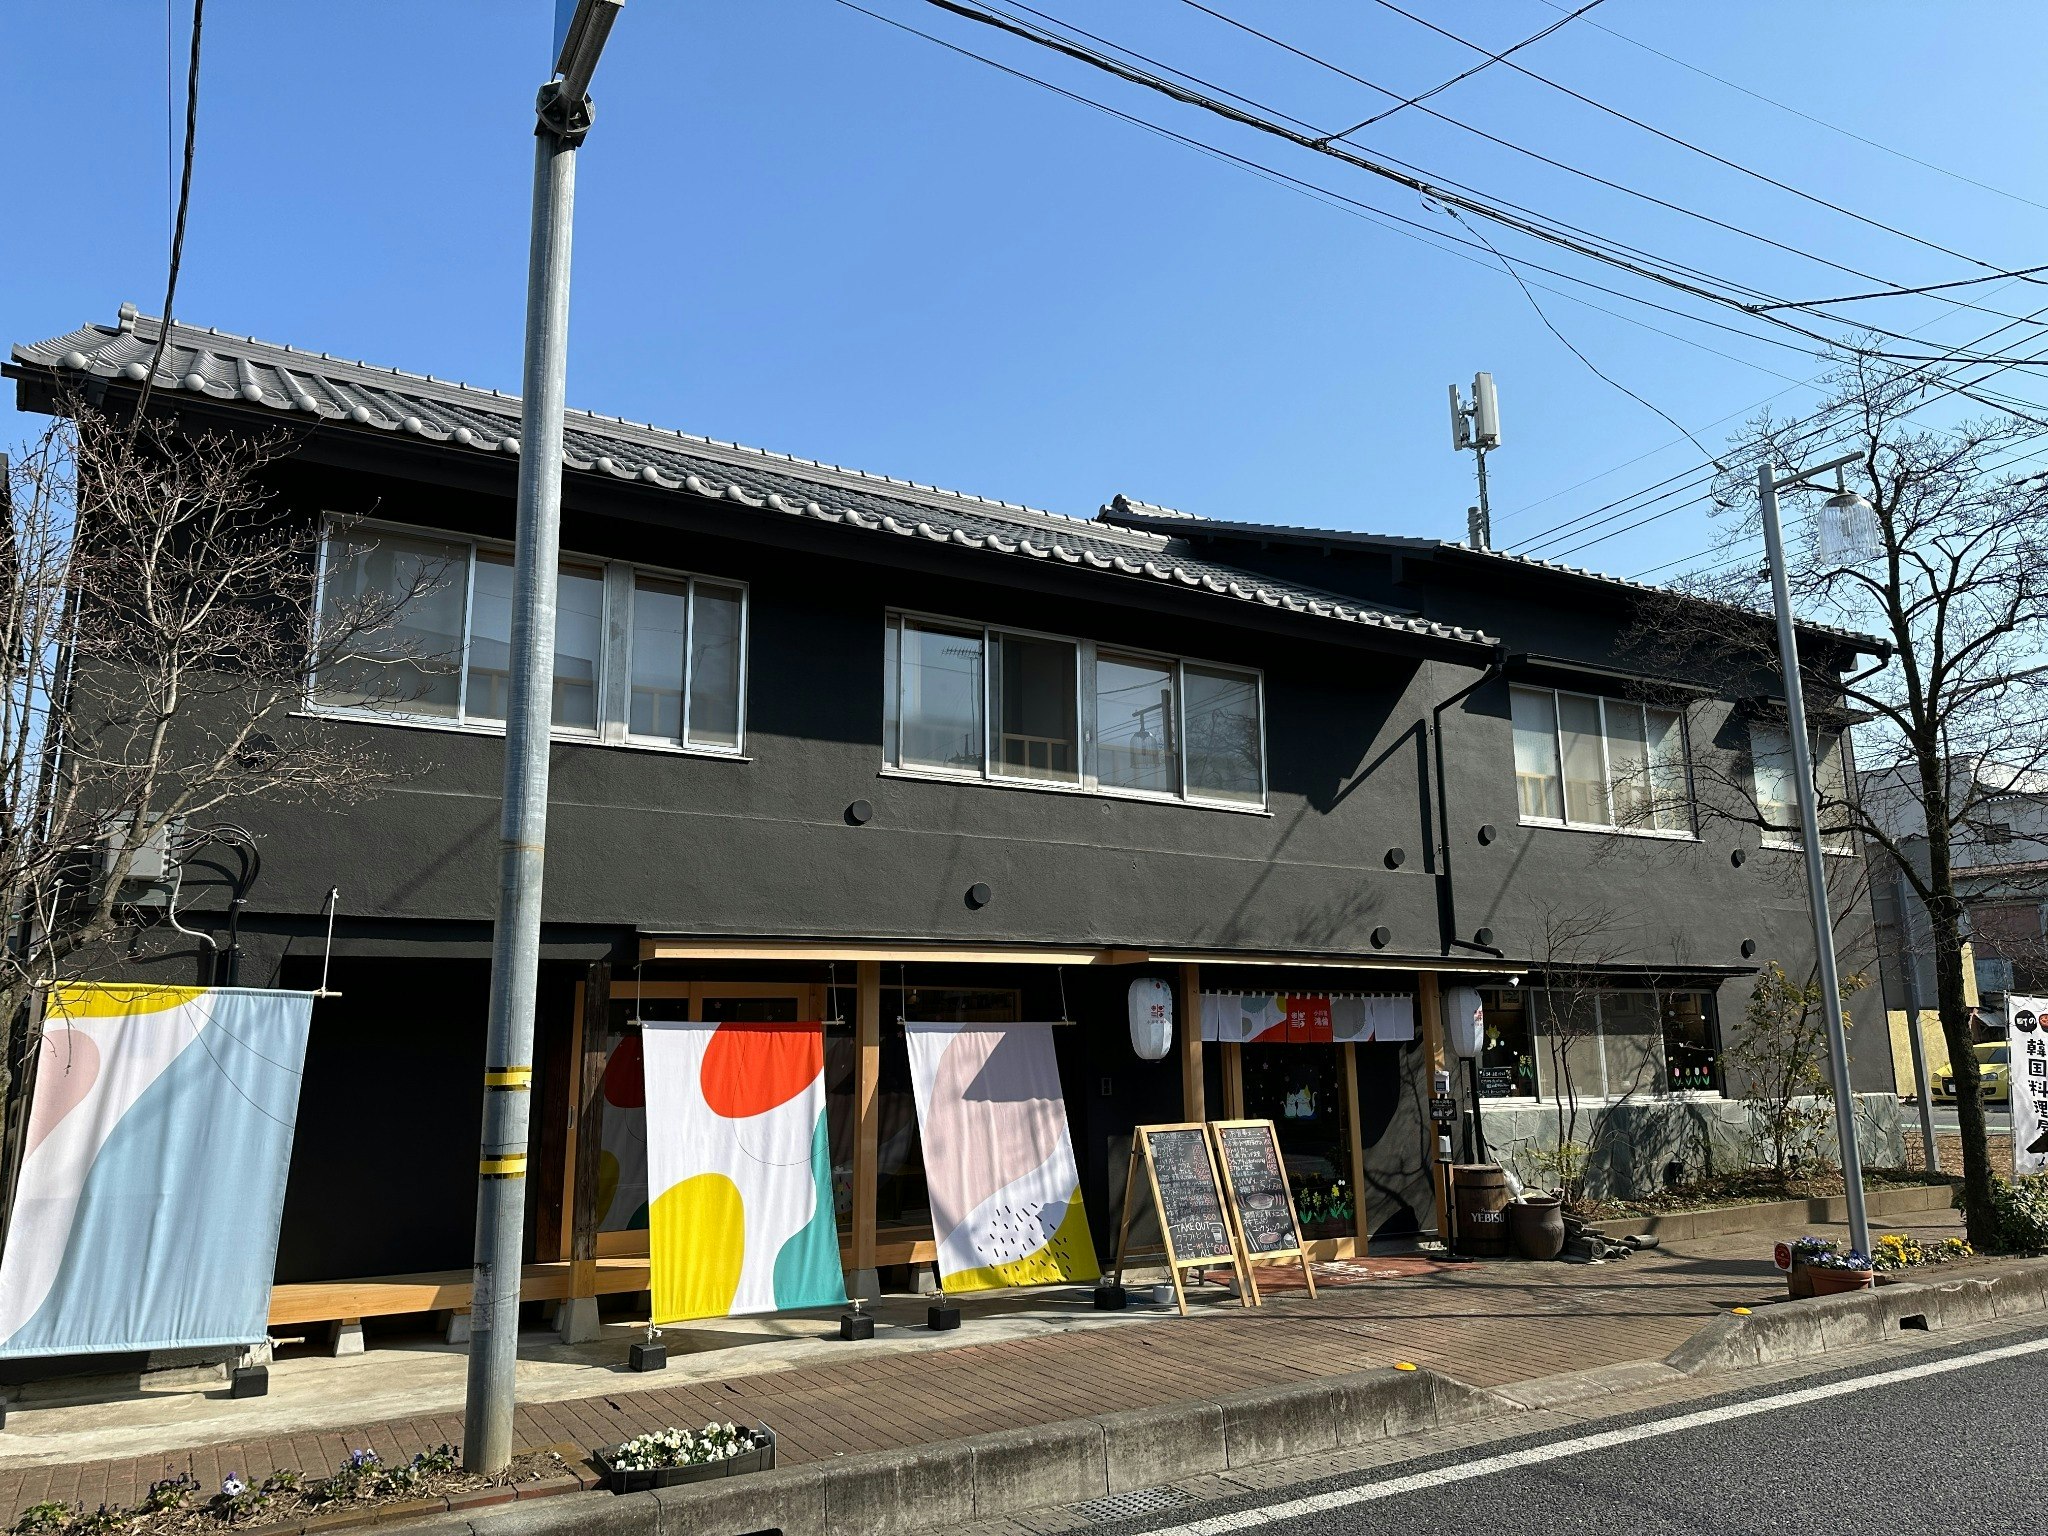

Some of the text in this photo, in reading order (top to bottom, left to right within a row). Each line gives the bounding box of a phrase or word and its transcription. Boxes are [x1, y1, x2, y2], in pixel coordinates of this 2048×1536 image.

[2016, 1017, 2036, 1027] 町の
[1470, 1212, 1505, 1223] YEBISU
[1176, 1221, 1210, 1233] TAKE OUT
[1200, 1248, 1213, 1258] ALL
[1213, 1243, 1230, 1254] 600
